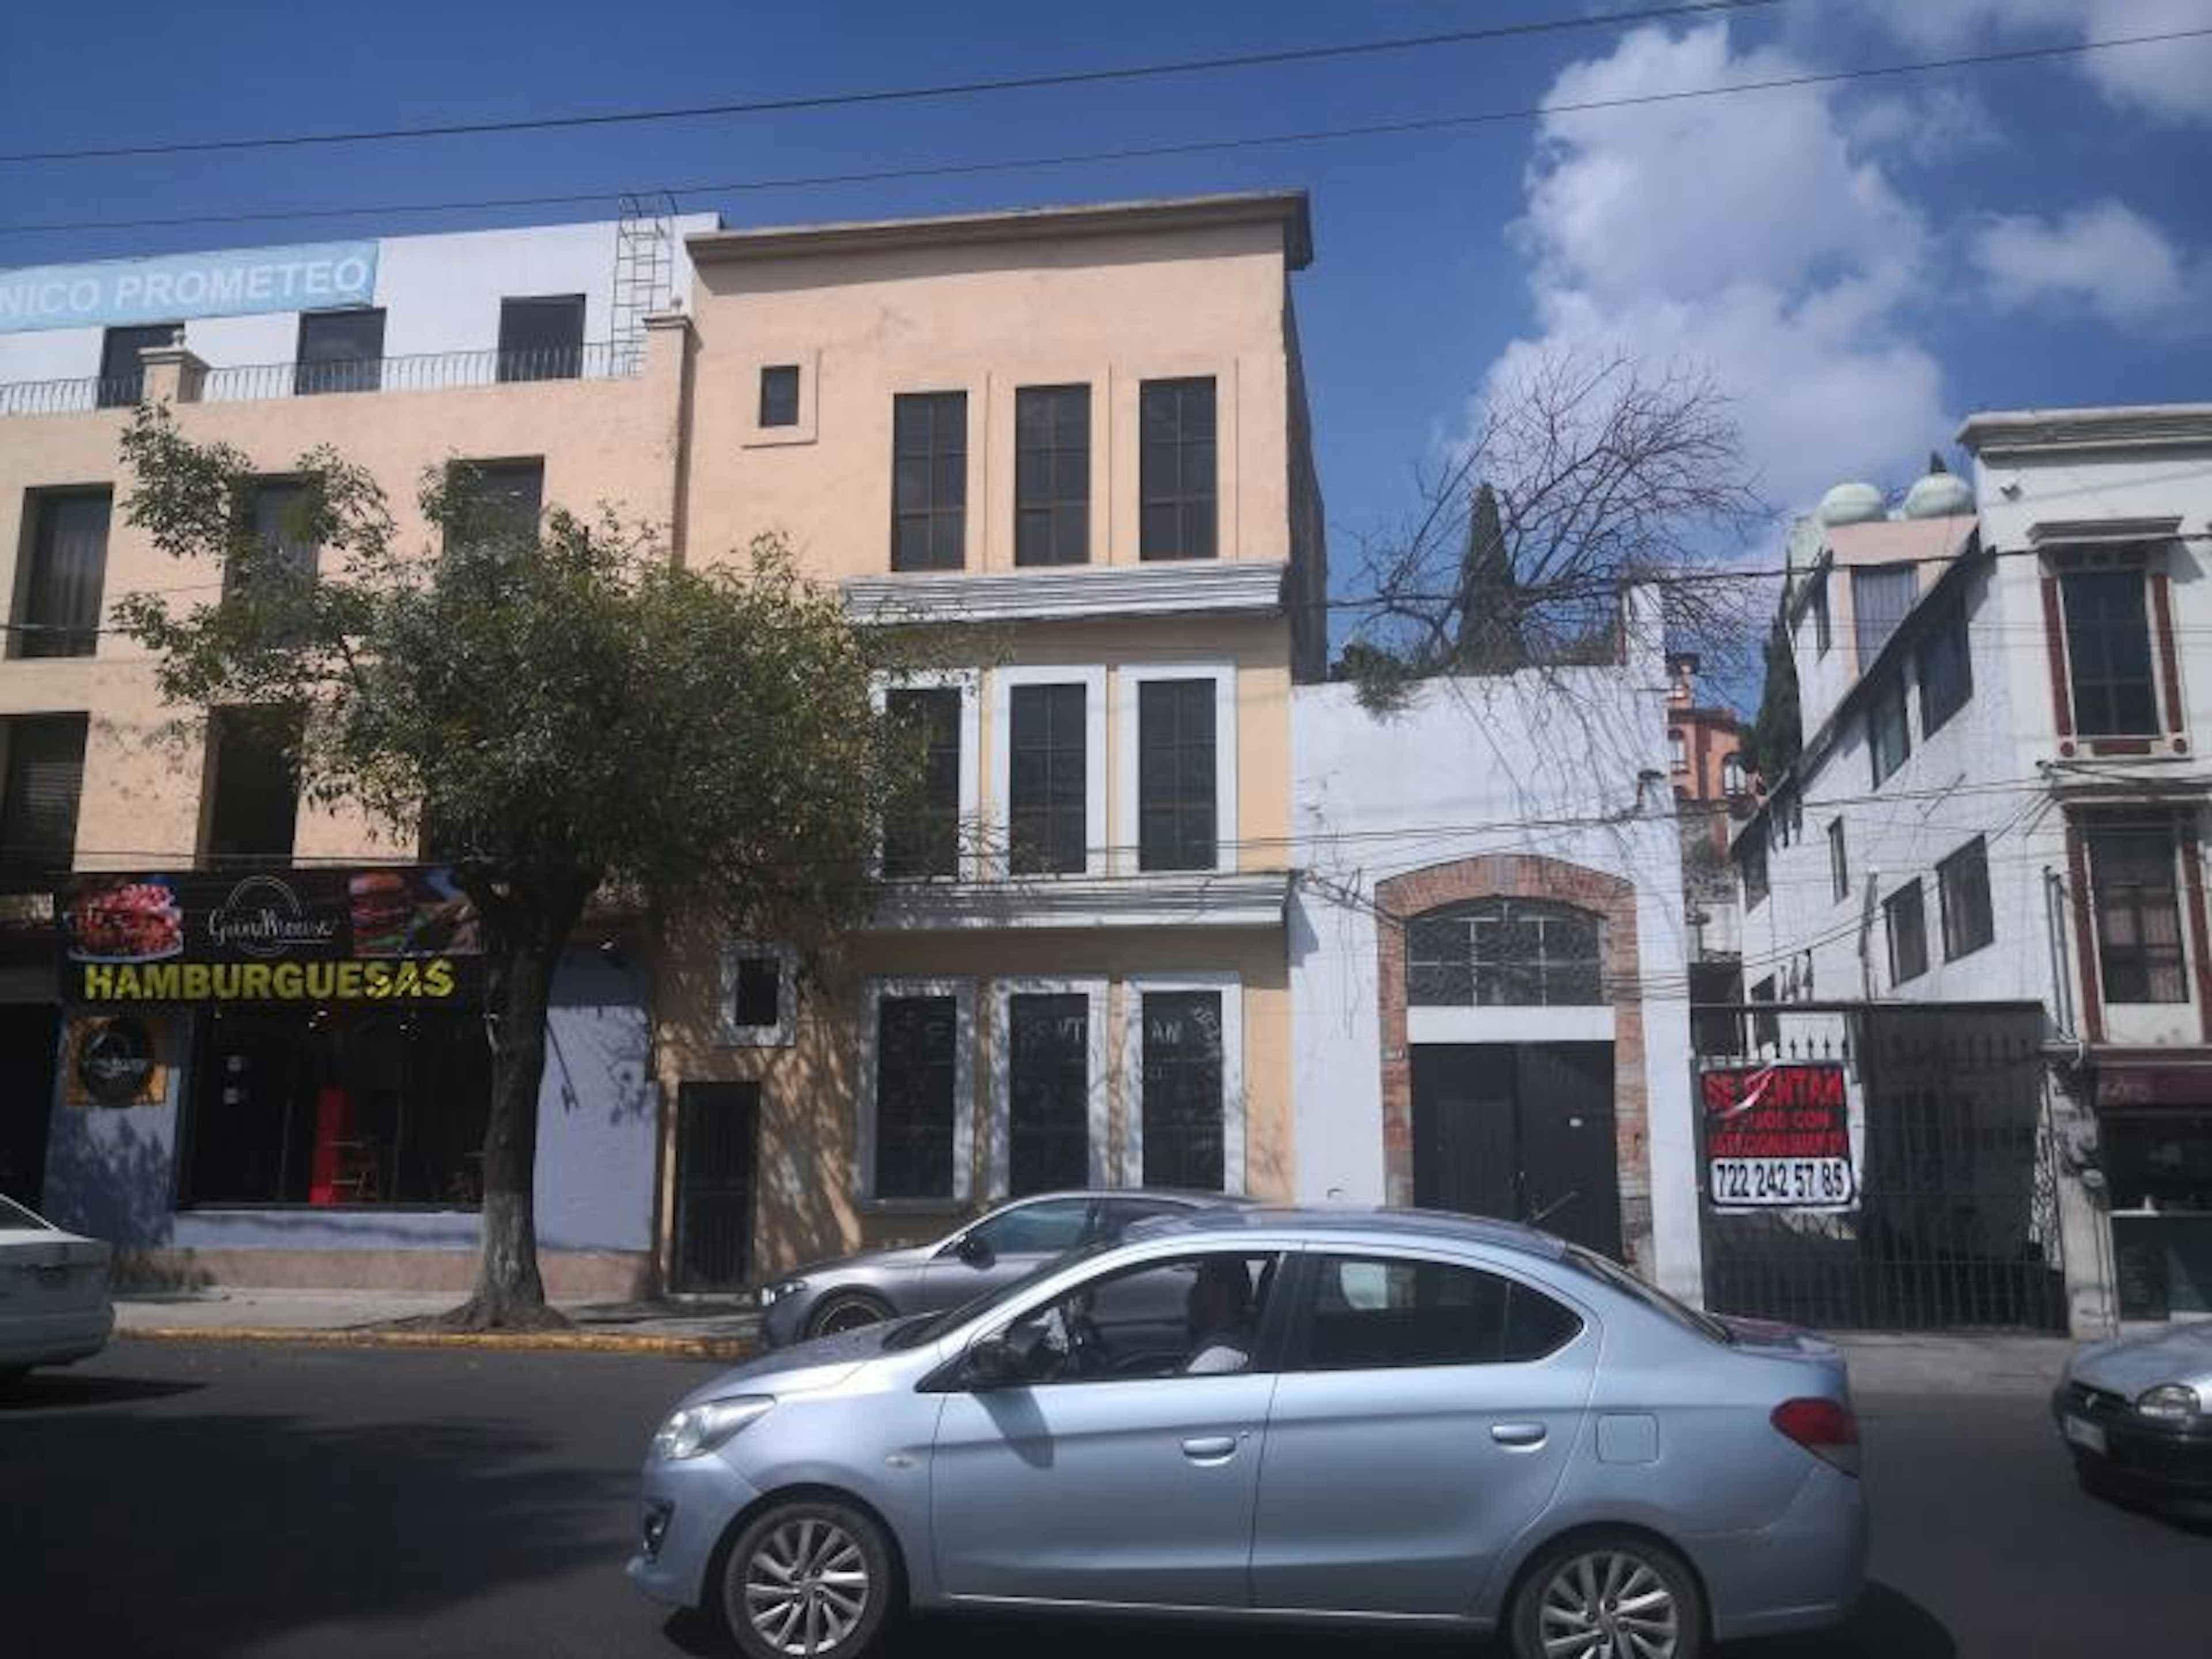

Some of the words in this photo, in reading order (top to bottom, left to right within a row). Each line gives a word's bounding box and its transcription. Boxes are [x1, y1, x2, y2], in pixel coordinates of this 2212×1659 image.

[116, 256, 368, 308] PROMETEO
[85, 960, 454, 1000] HAMBURGUESAS
[1717, 1164, 1749, 1198] 722
[1756, 1163, 1789, 1197] 242
[1794, 1163, 1814, 1197] 57
[1823, 1162, 1843, 1196] 85
